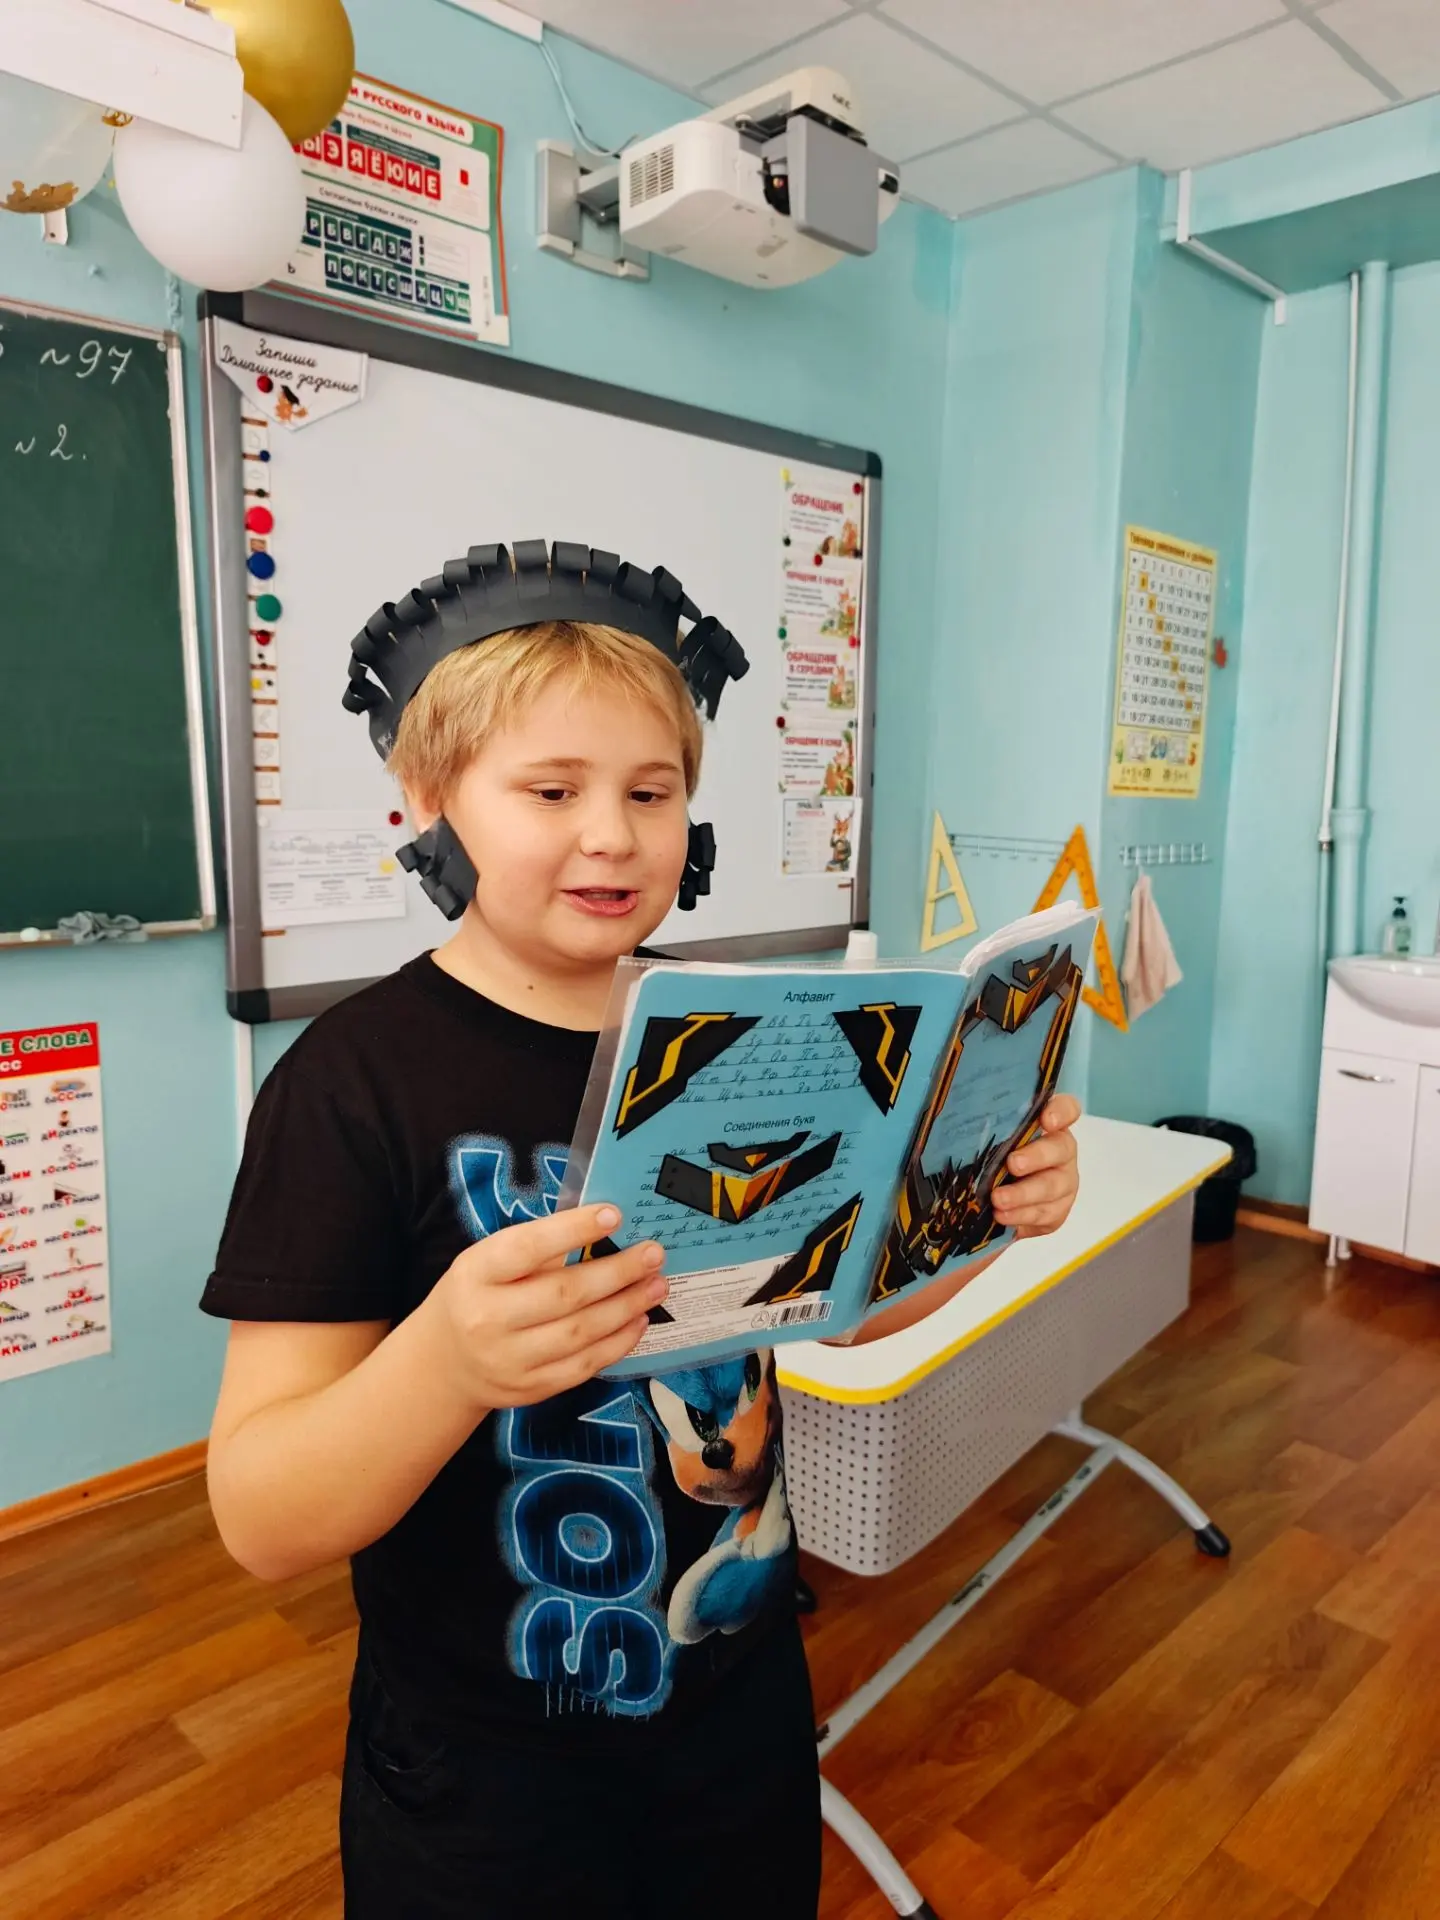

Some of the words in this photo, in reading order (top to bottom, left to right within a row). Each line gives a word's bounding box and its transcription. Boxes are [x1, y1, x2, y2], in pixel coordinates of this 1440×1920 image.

[363, 91, 422, 120] РУССКОГО
[427, 113, 465, 137] ЯЗЫКА
[255, 338, 317, 368] Запиши
[220, 344, 294, 381] Домашнее
[296, 373, 359, 394] задание
[783, 991, 836, 1004] Алфавит
[20, 1031, 92, 1053] СЛОВА
[723, 1117, 791, 1133] Соединения
[793, 1115, 816, 1131] букв
